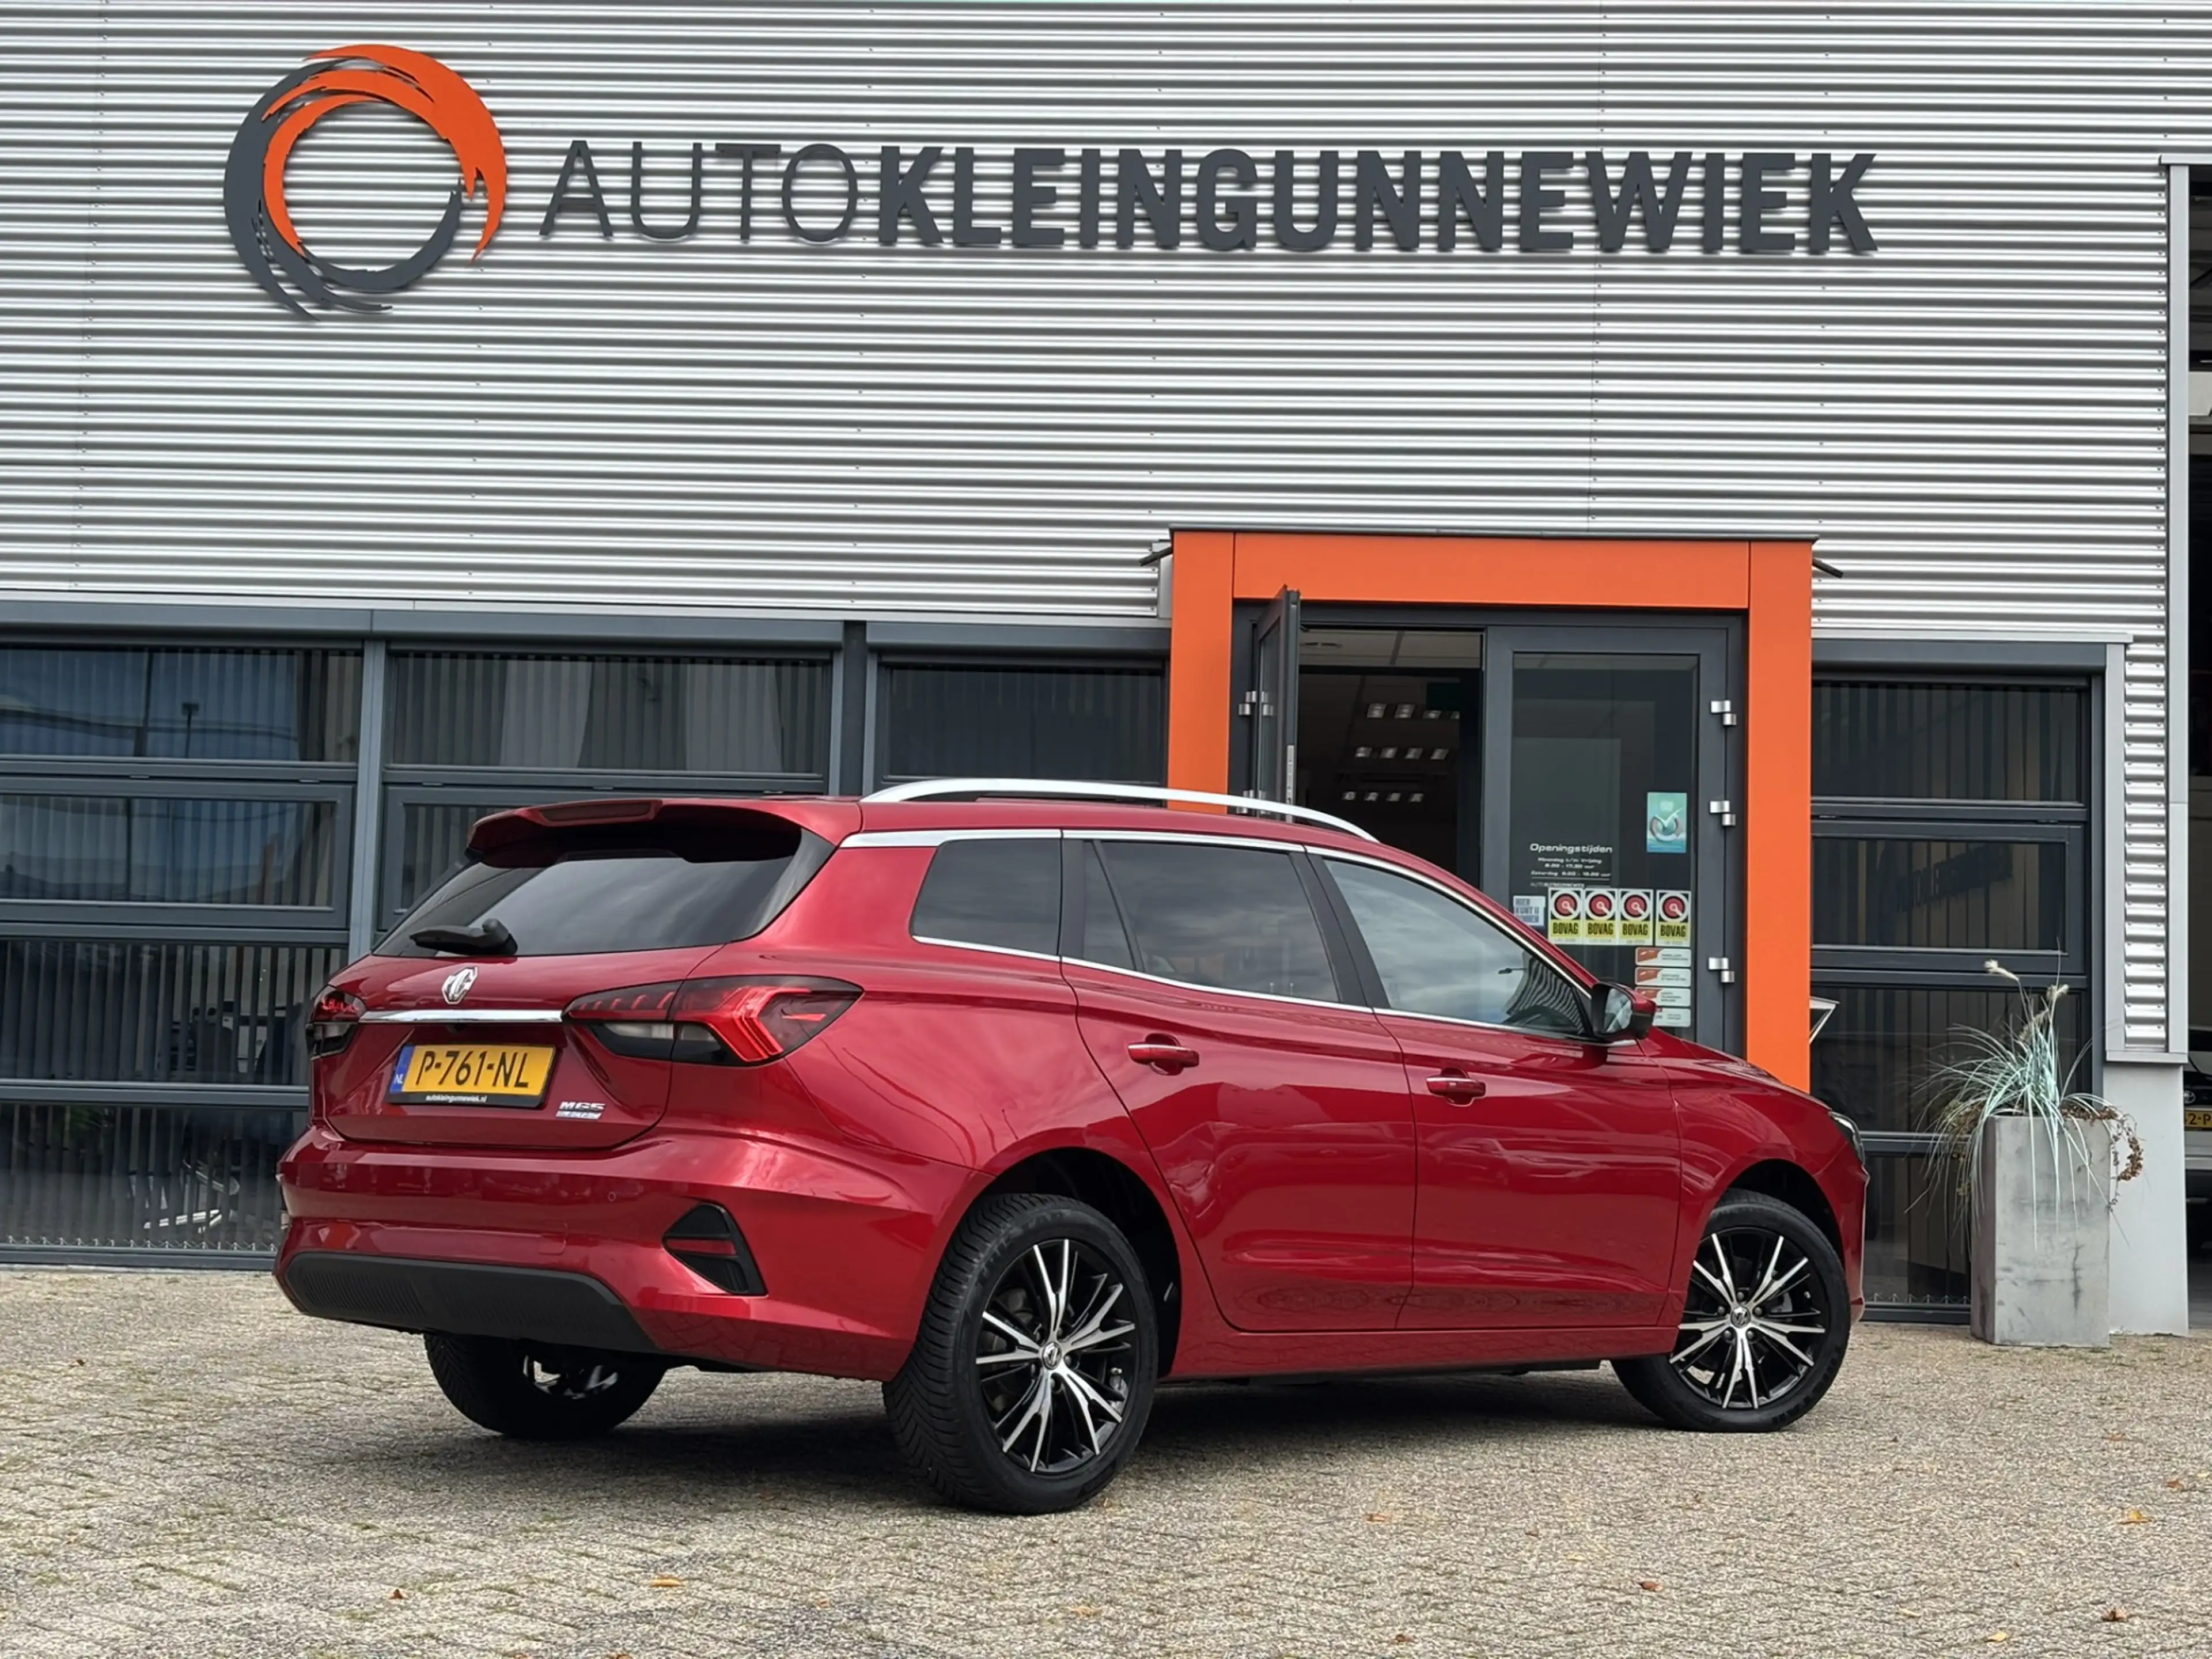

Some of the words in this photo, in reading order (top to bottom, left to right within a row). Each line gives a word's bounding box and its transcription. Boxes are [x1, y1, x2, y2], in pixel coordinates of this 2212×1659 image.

[1529, 843, 1613, 854] Openingstijden
[1552, 922, 1579, 934] BOVAG
[1588, 923, 1614, 935] BOVAG
[1622, 923, 1649, 935] BOVAG
[1660, 925, 1687, 937] BOVAG
[416, 1050, 529, 1088] P-761-NL
[393, 1073, 404, 1084] NL
[559, 1101, 606, 1111] MG5
[2184, 1113, 2211, 1125] 2-P
